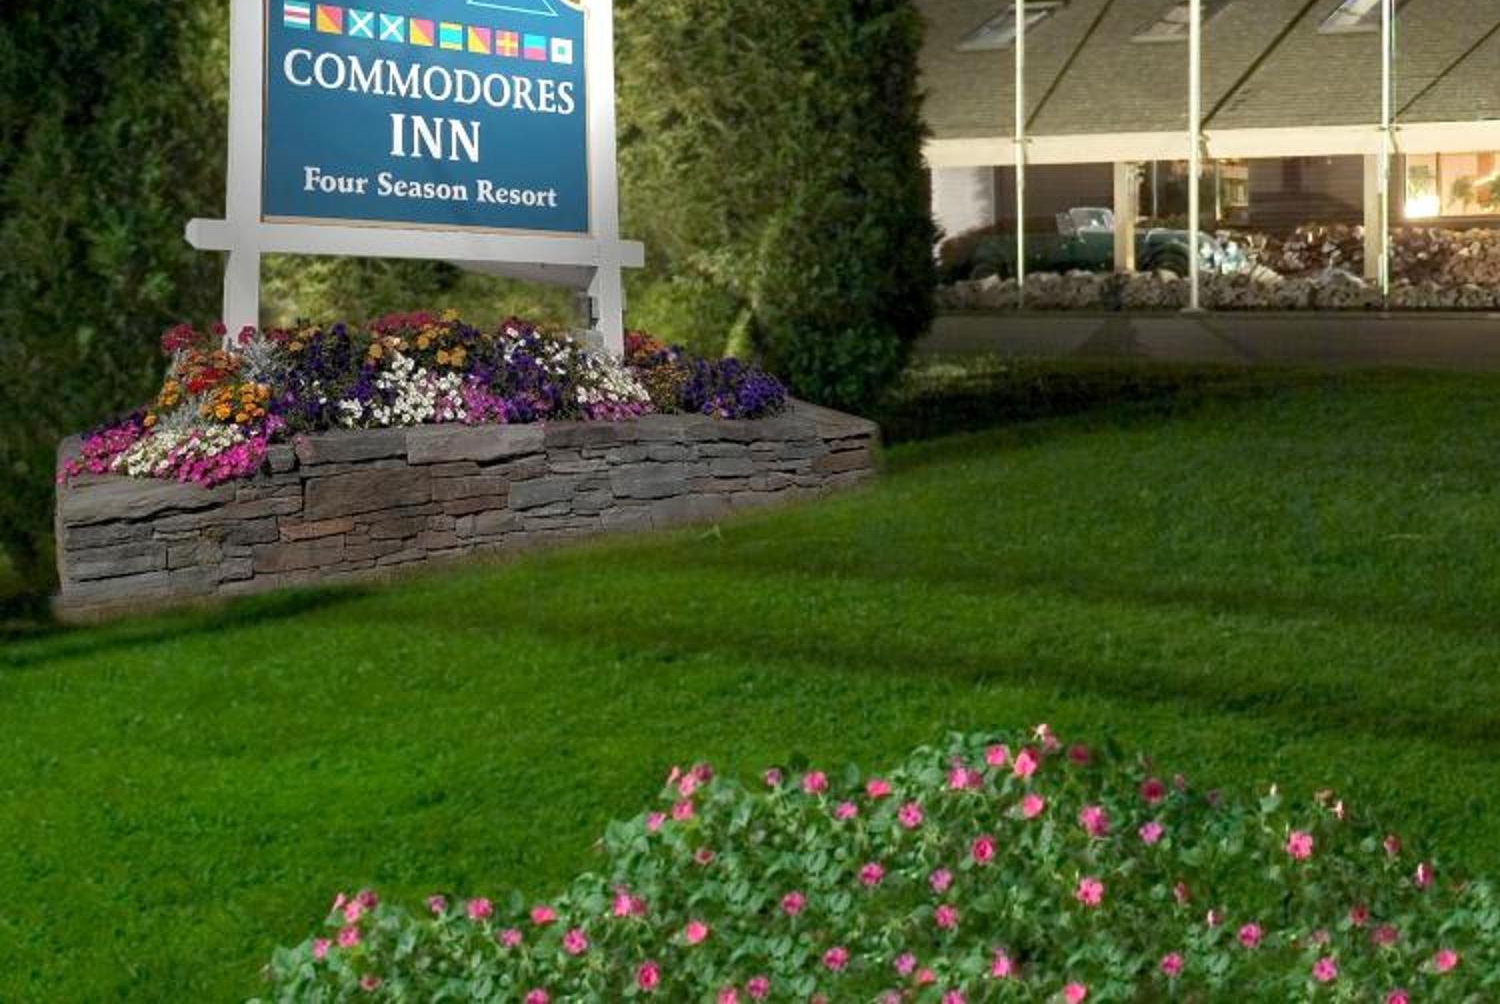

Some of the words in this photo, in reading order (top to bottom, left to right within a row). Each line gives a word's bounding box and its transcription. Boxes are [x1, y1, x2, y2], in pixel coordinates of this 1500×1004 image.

[284, 49, 575, 115] COMMODORES
[389, 113, 481, 163] INN
[304, 166, 368, 195] Four
[377, 172, 468, 202] Season
[476, 179, 558, 207] Resort
